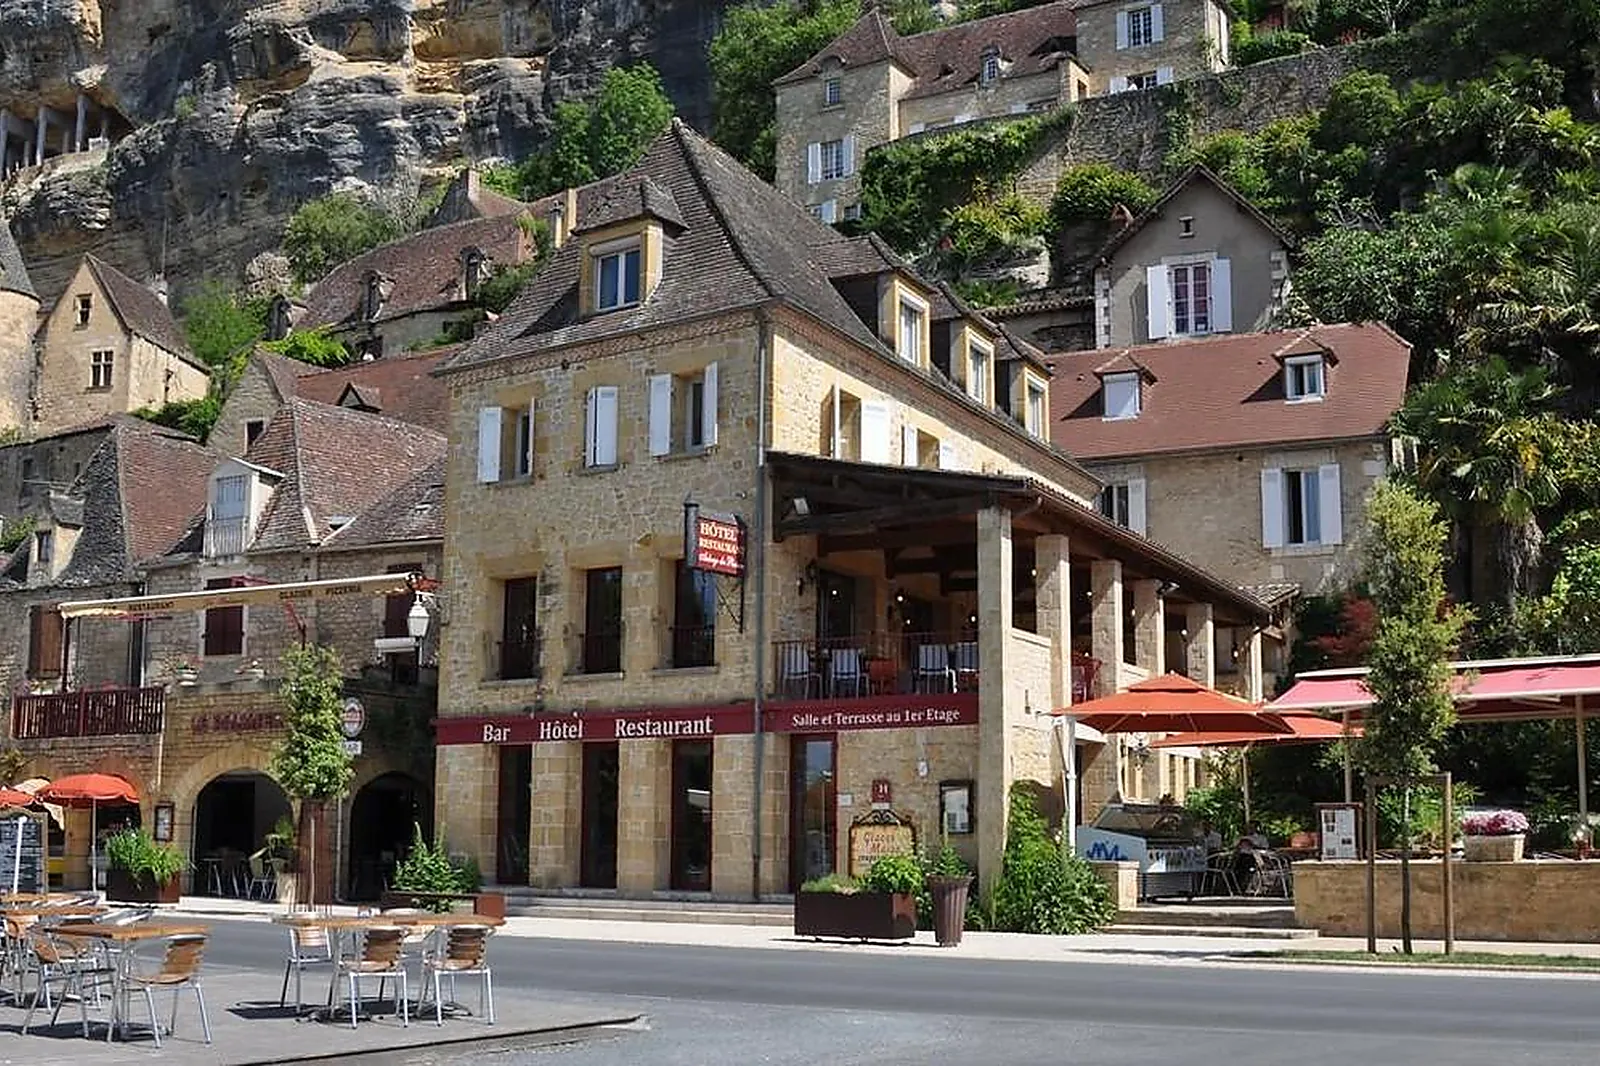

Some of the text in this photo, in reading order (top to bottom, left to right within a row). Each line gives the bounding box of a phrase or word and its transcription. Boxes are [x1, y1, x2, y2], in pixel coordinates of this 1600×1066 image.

[700, 521, 738, 541] HÔTEL
[483, 715, 713, 742] Bar Hôtel Restaurant
[793, 713, 819, 727] Salle
[822, 713, 832, 725] et
[834, 711, 884, 725] Terrasse
[886, 711, 901, 722] au
